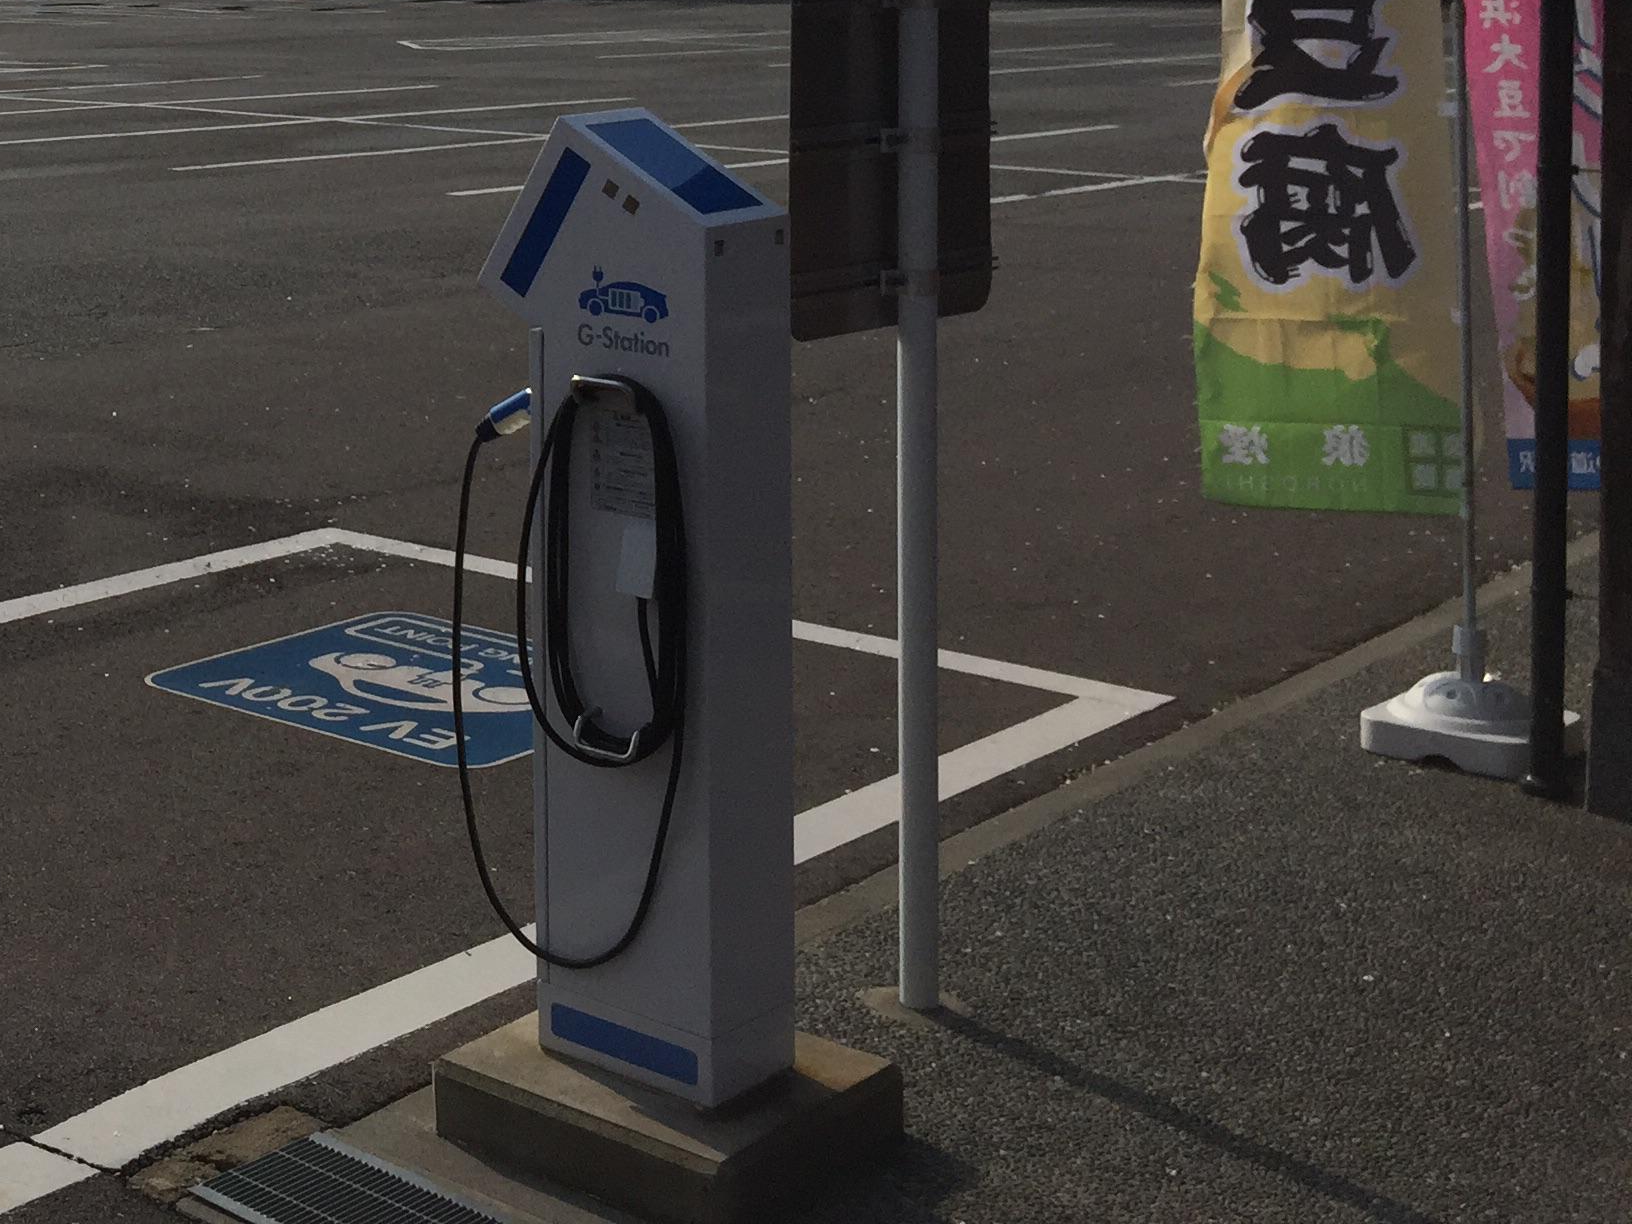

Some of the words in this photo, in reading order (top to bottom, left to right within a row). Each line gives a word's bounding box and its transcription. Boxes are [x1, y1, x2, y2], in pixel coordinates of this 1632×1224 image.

[578, 323, 670, 357] G-Station
[374, 626, 479, 653] POINT
[199, 677, 371, 721] 200V
[360, 720, 471, 750] EV
